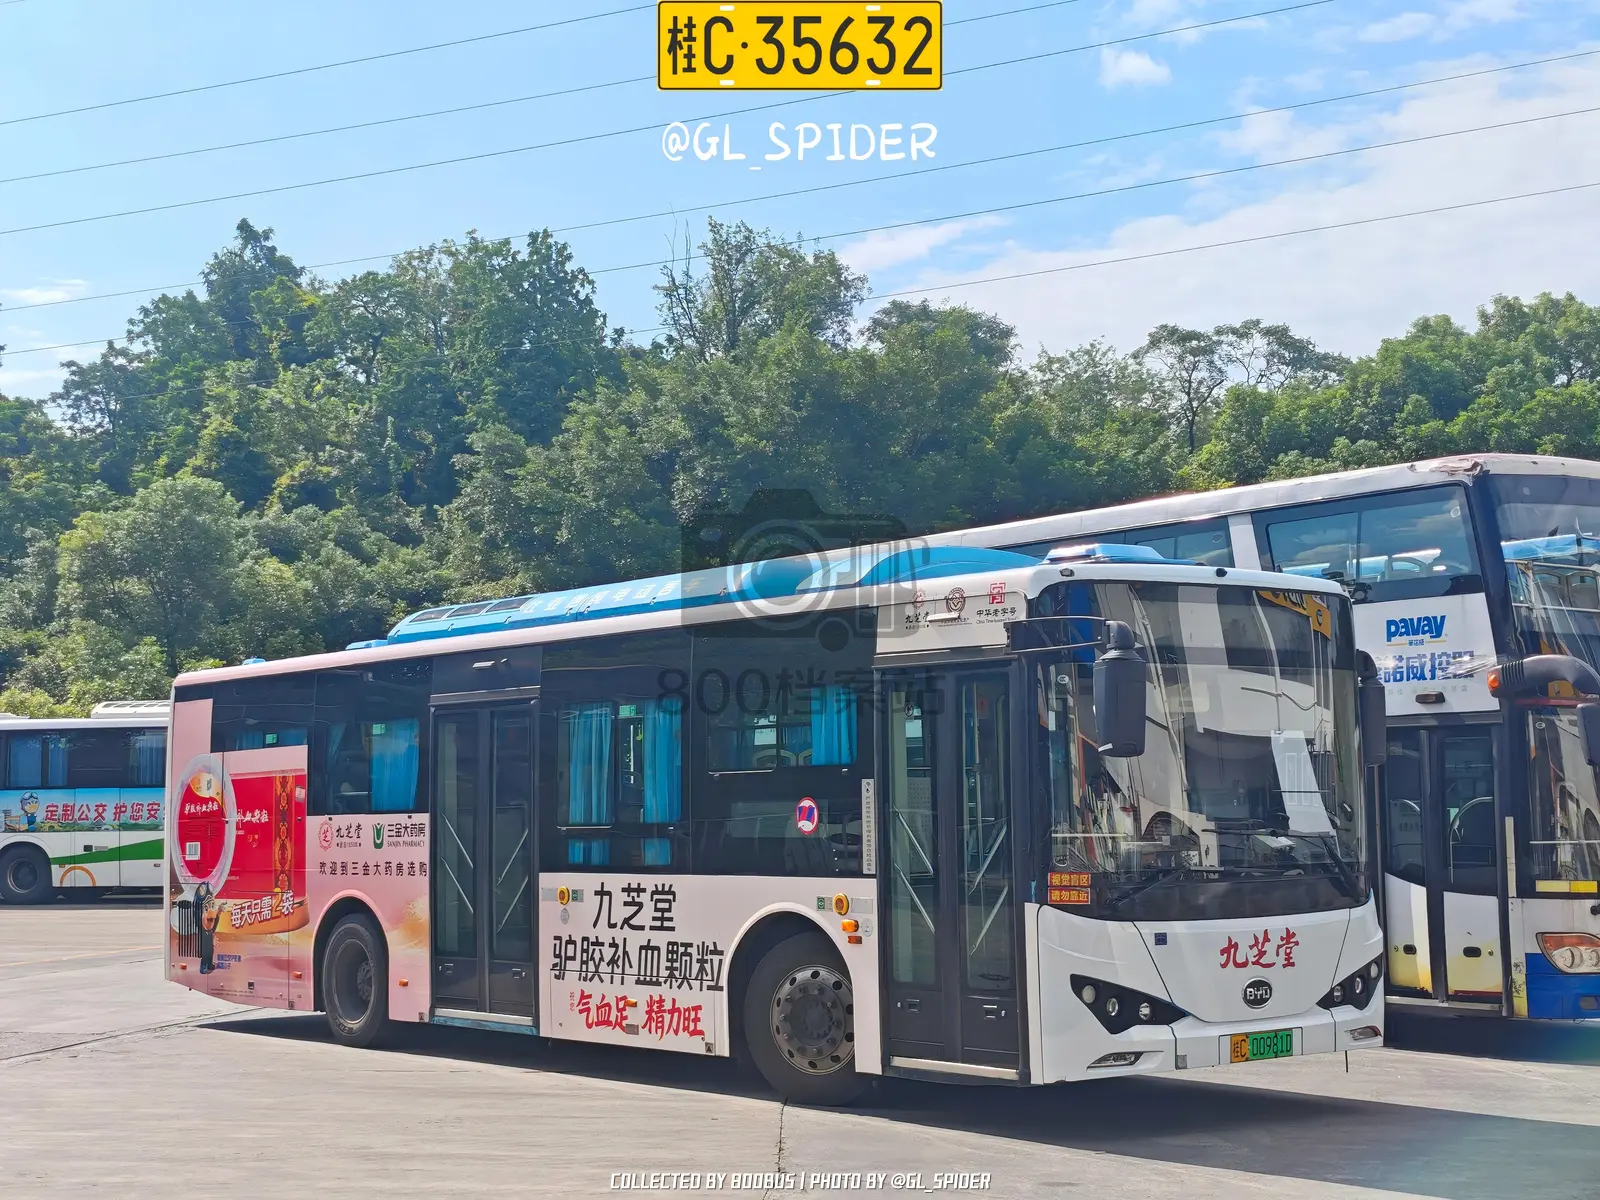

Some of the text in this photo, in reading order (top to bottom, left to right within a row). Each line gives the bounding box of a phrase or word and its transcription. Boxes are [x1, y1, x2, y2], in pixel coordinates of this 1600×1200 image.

[976, 606, 1017, 619] 中华老字号
[1386, 615, 1447, 642] pavay
[45, 802, 165, 822] 定制公交 护您安
[335, 822, 363, 839] 九芝堂
[387, 823, 426, 838] 三金大药房
[387, 840, 426, 849] SANJIN PHARMACY
[318, 861, 428, 877] 欢迎到三金大药房选购
[1051, 873, 1089, 886] 视觉盲区
[1051, 889, 1088, 901] 请勿靠近
[231, 887, 294, 928] 每天只需2袋
[592, 881, 677, 932] 九芝堂
[1219, 927, 1300, 969] 九芝堂
[551, 934, 725, 992] 驴胶补血颗粒
[1246, 986, 1270, 1000] BYD
[575, 988, 629, 1035] 气血足
[641, 993, 706, 1042] 精力旺
